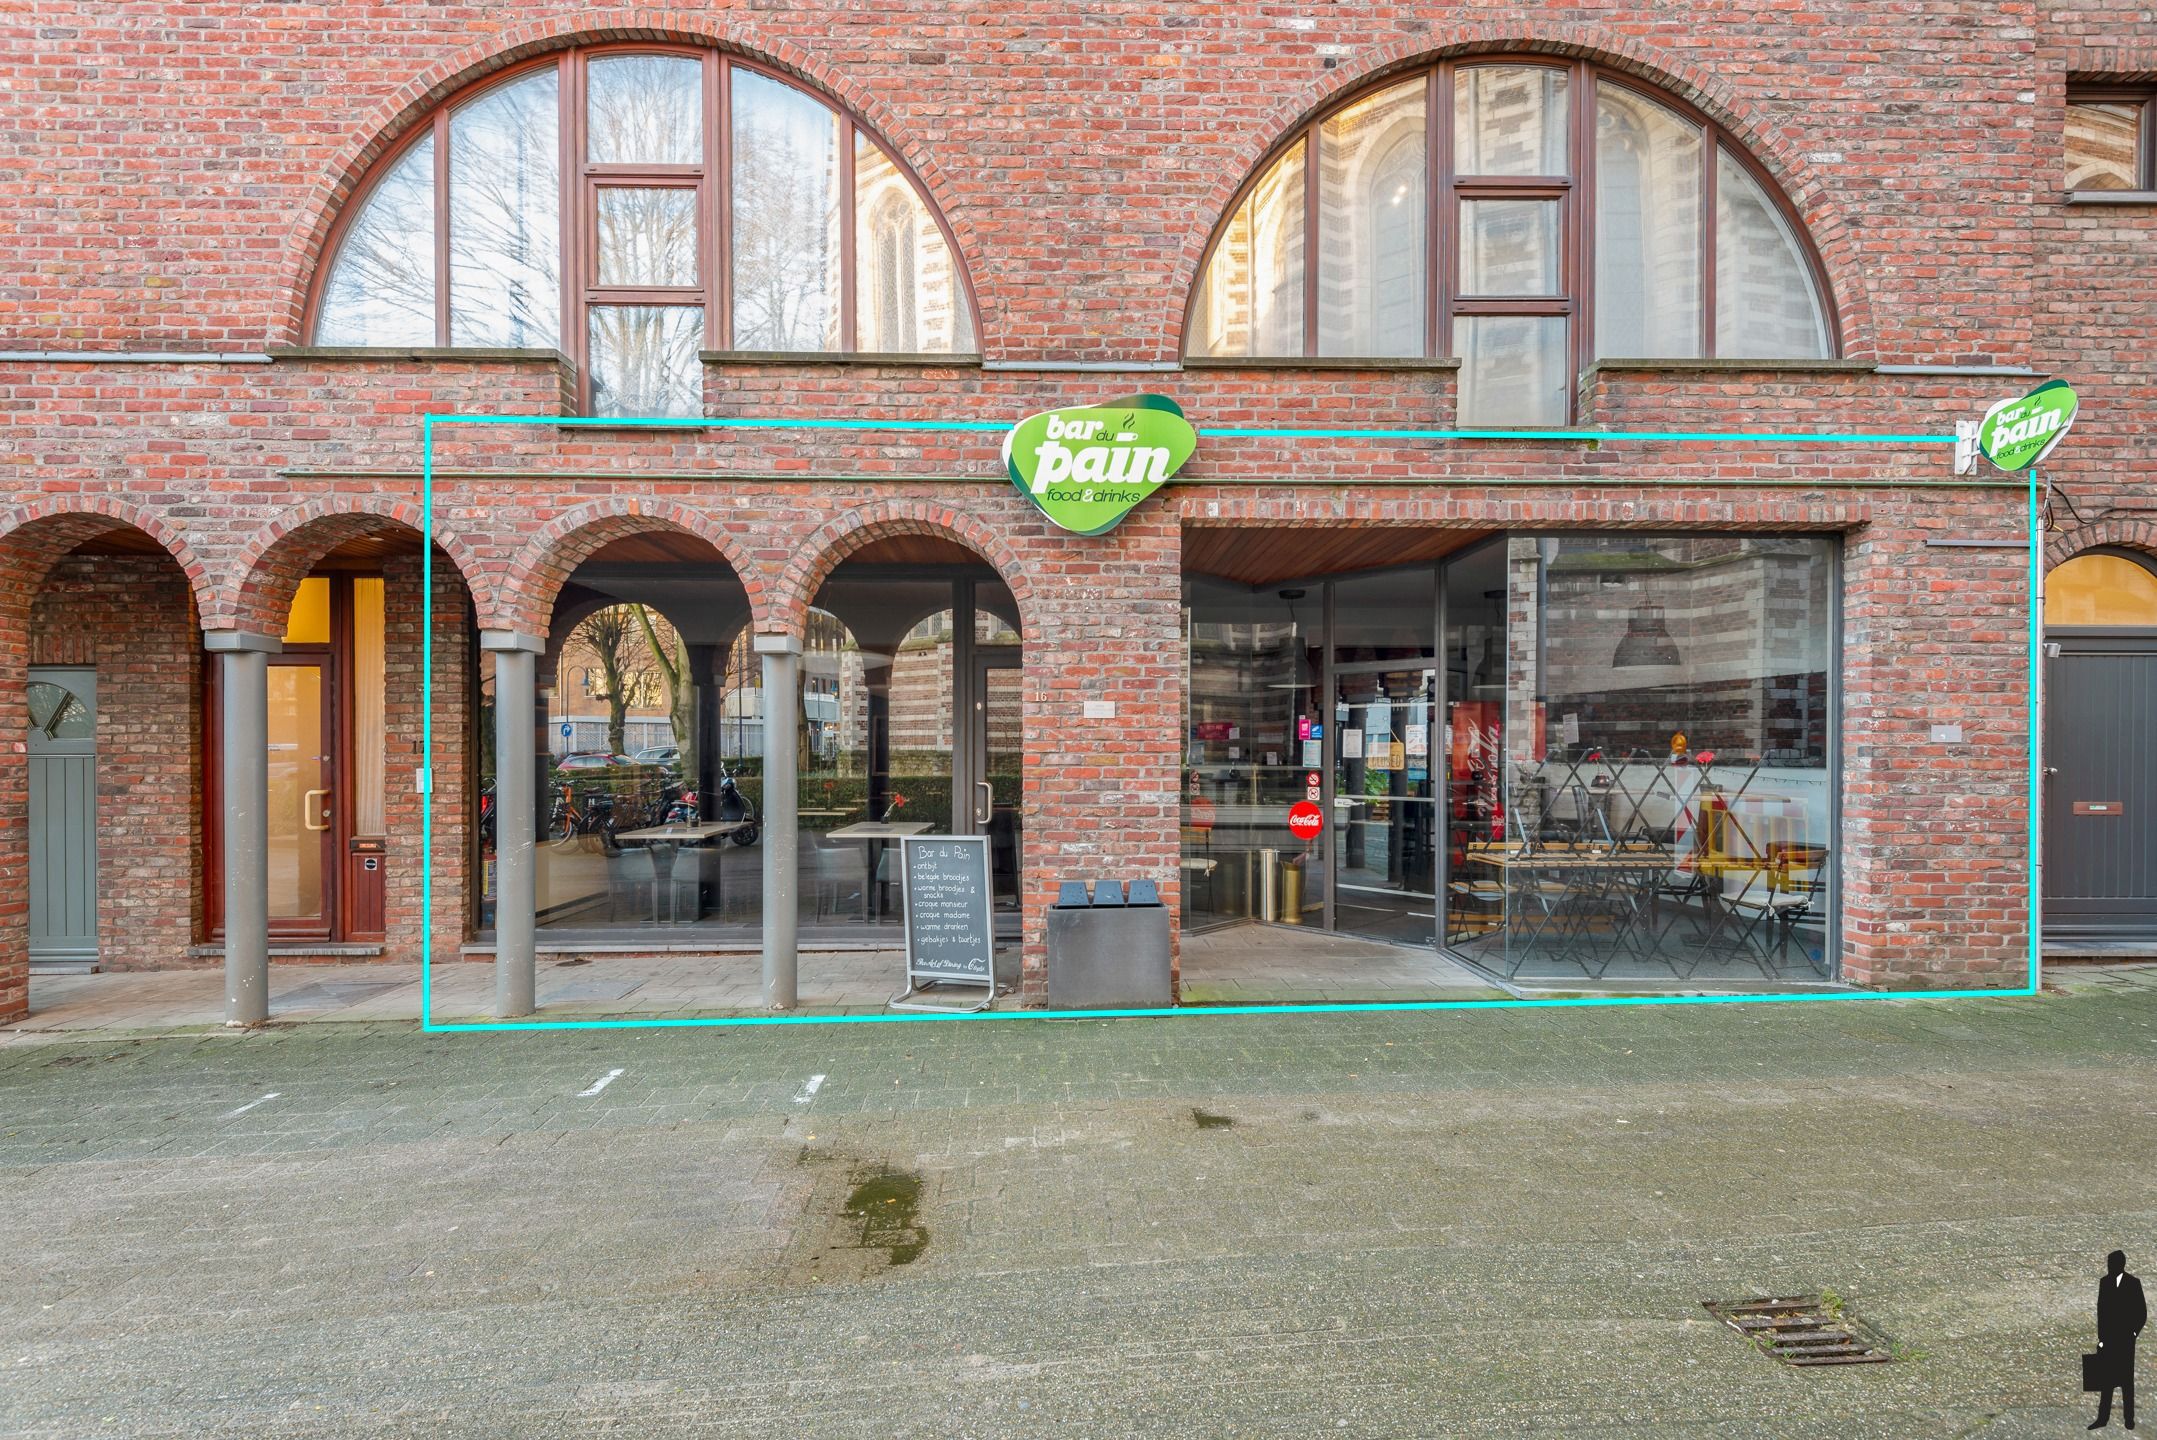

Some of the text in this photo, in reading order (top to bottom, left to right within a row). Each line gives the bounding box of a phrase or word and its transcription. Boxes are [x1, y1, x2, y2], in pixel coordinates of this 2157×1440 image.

[1997, 407, 2025, 425] bar
[1047, 414, 1115, 442] bar du
[1989, 408, 2062, 458] pain
[1030, 440, 1170, 494] pain
[1035, 691, 1047, 702] 16
[918, 845, 971, 860] Bar du Pain
[942, 873, 970, 884] broodjes
[938, 884, 965, 896] broodjes
[970, 886, 976, 894] &
[918, 901, 939, 909] croque
[919, 910, 971, 920] croque madame
[920, 922, 969, 931] warme dranken
